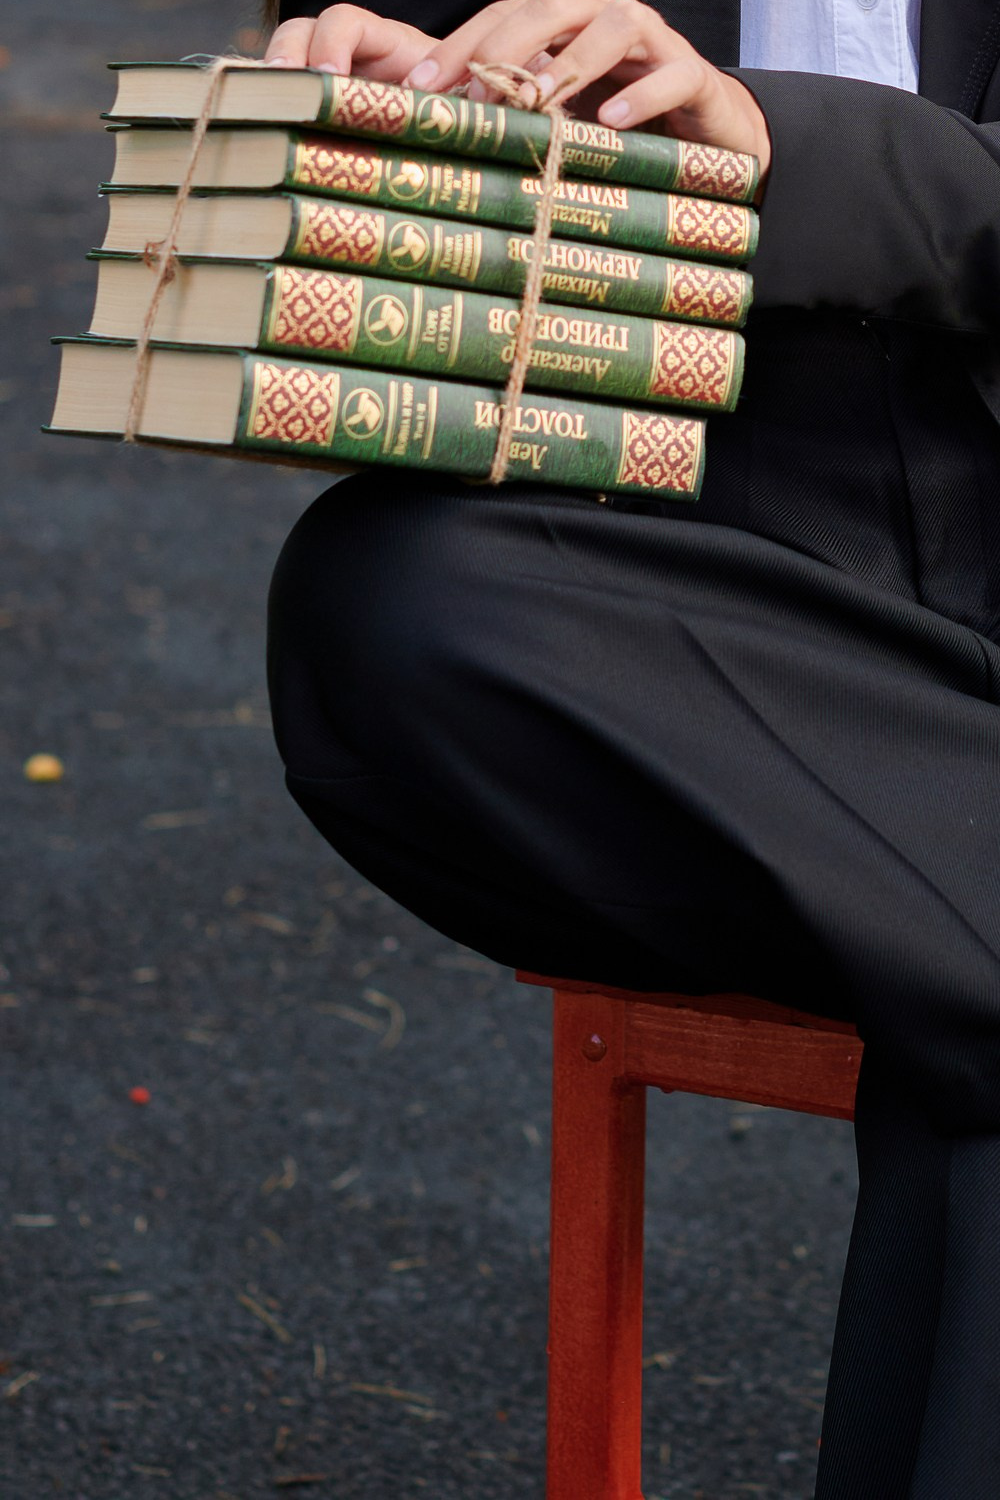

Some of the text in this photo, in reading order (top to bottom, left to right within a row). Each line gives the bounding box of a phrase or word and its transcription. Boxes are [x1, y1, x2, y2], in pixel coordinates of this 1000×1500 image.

[563, 120, 624, 151] ЧЕХОВ
[563, 148, 618, 175] Антон
[541, 272, 610, 302] Михаи
[489, 308, 629, 351] ГРИБОЕОВ
[501, 338, 612, 382] Алексанр
[509, 441, 548, 470] Лев
